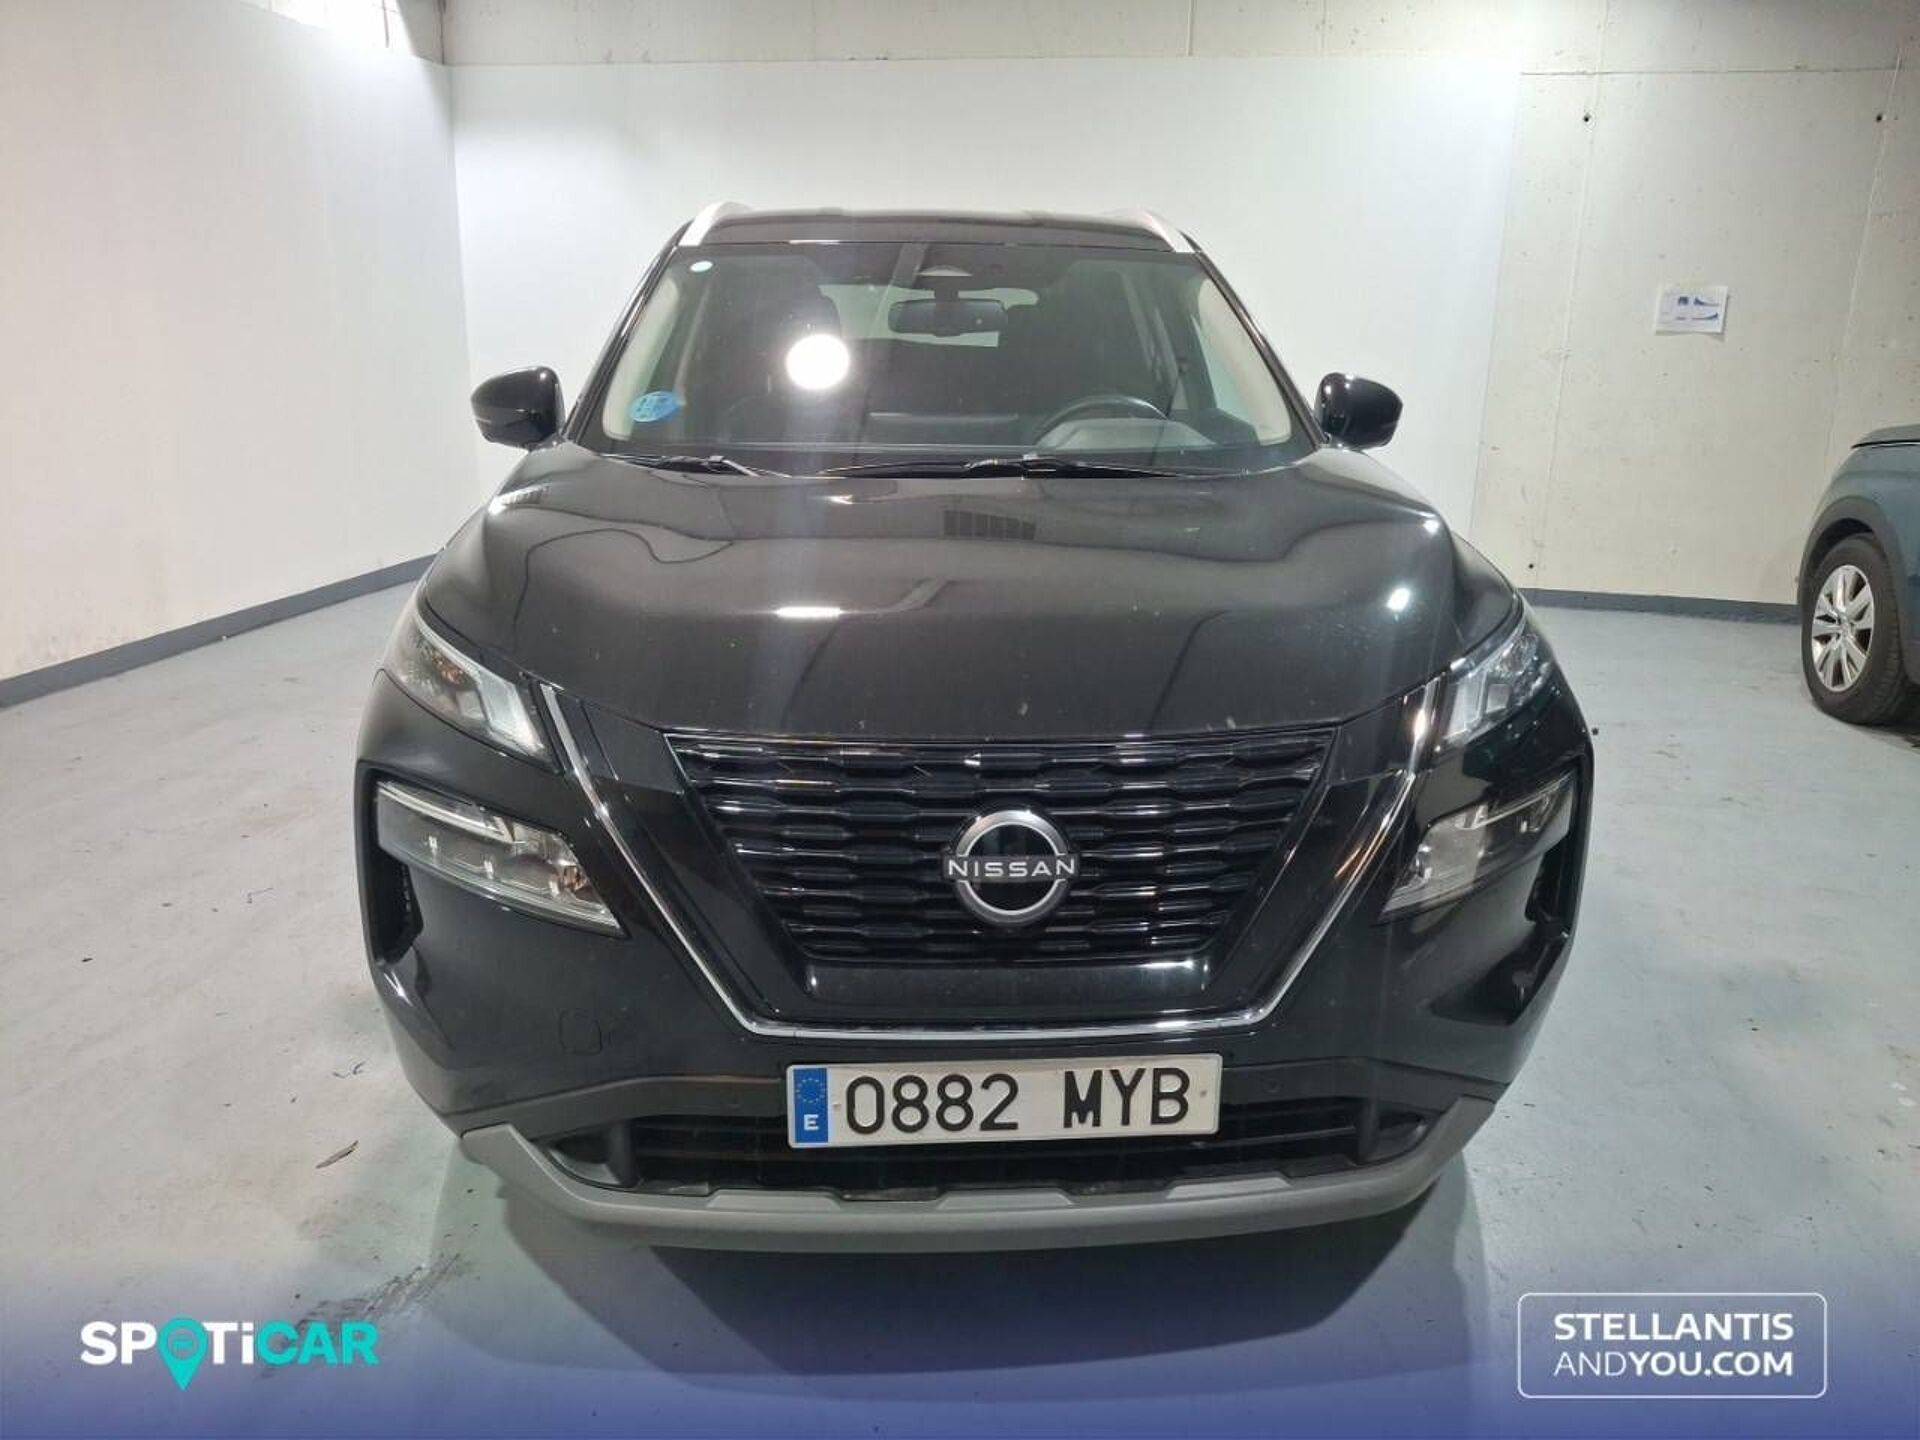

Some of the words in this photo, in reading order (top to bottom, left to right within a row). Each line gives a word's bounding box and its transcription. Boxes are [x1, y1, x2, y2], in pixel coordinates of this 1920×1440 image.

[948, 858, 1075, 877] NISSAN
[803, 1114, 819, 1130] E
[845, 1073, 1019, 1135] 0882
[1062, 1066, 1191, 1129] MYB
